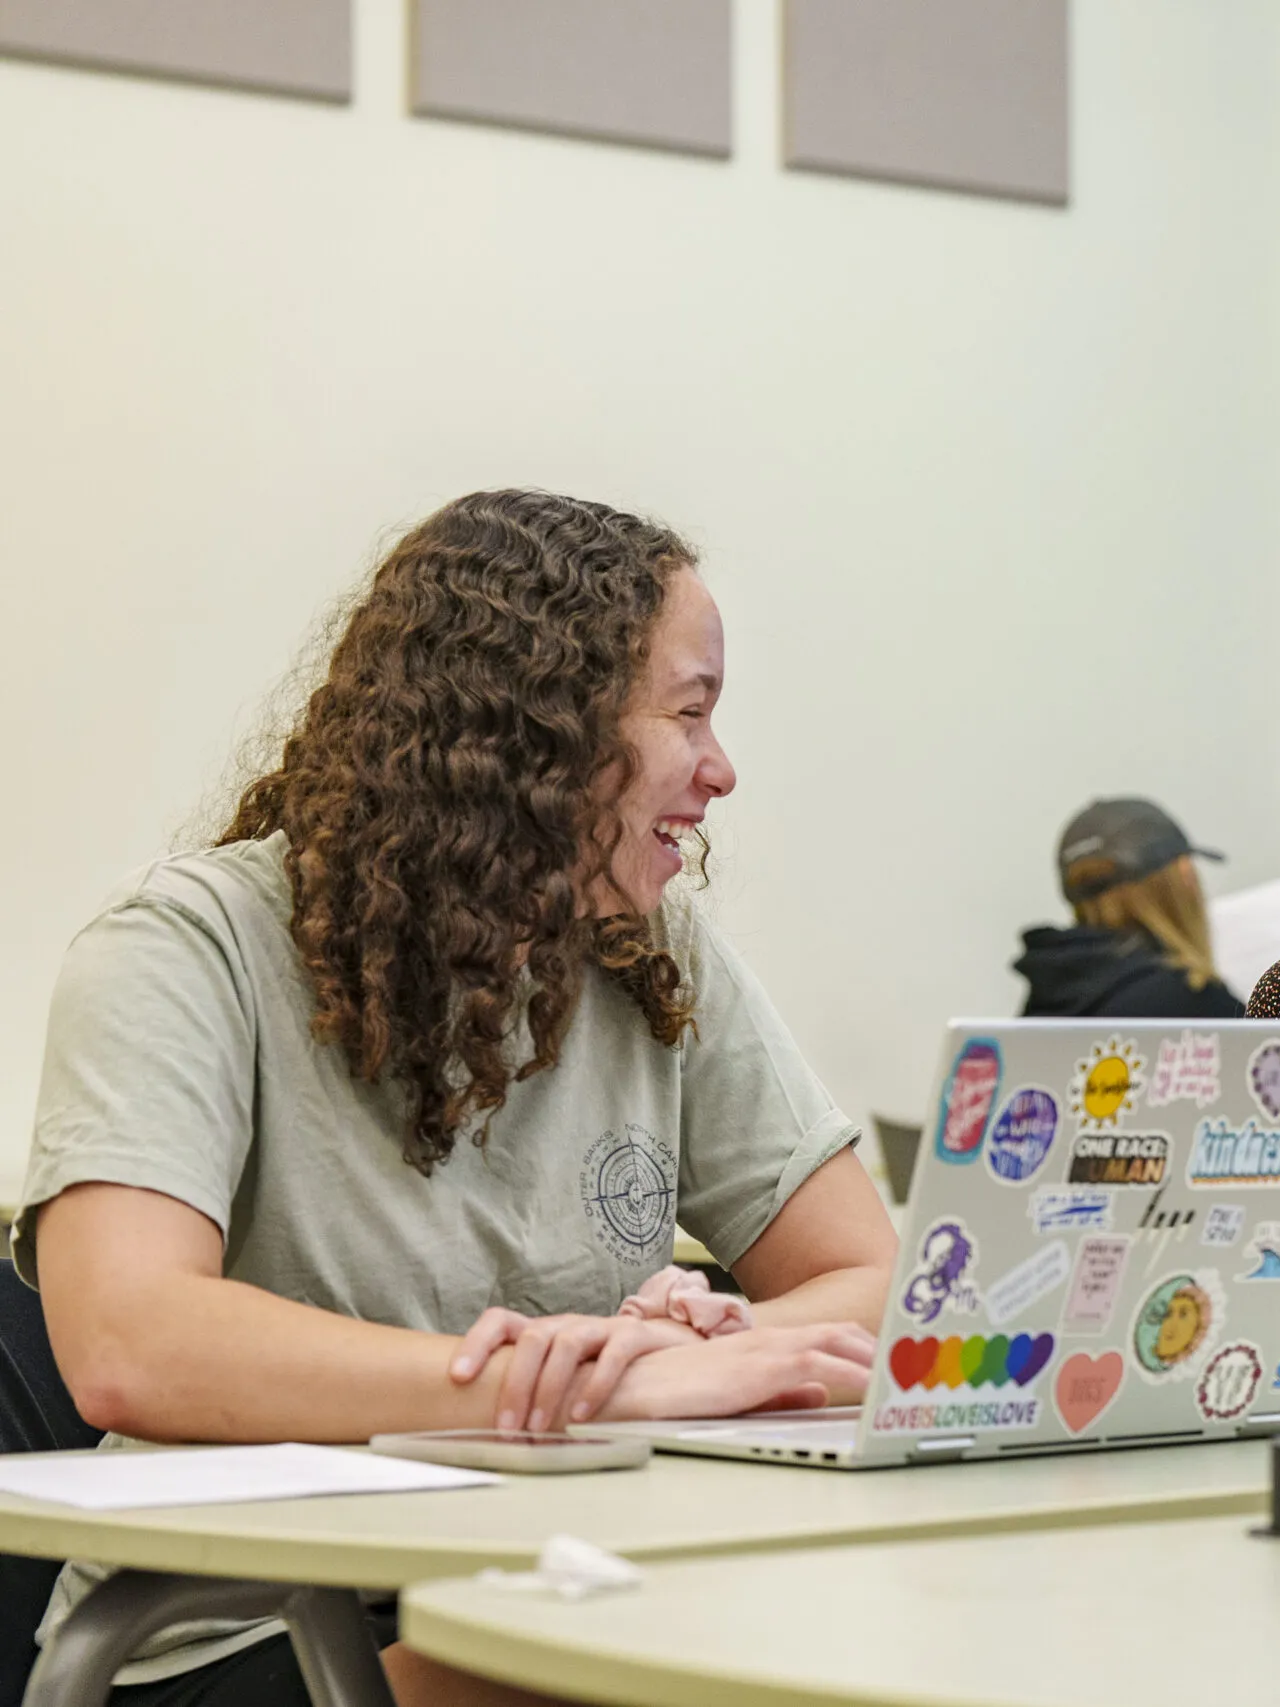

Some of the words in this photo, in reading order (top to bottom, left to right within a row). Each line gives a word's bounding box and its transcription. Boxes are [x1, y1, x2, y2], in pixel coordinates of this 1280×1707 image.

[583, 1130, 614, 1166] BANKS
[1075, 1136, 1113, 1158] ONE
[1114, 1136, 1164, 1158] RACE
[1070, 1157, 1166, 1183] UMAN
